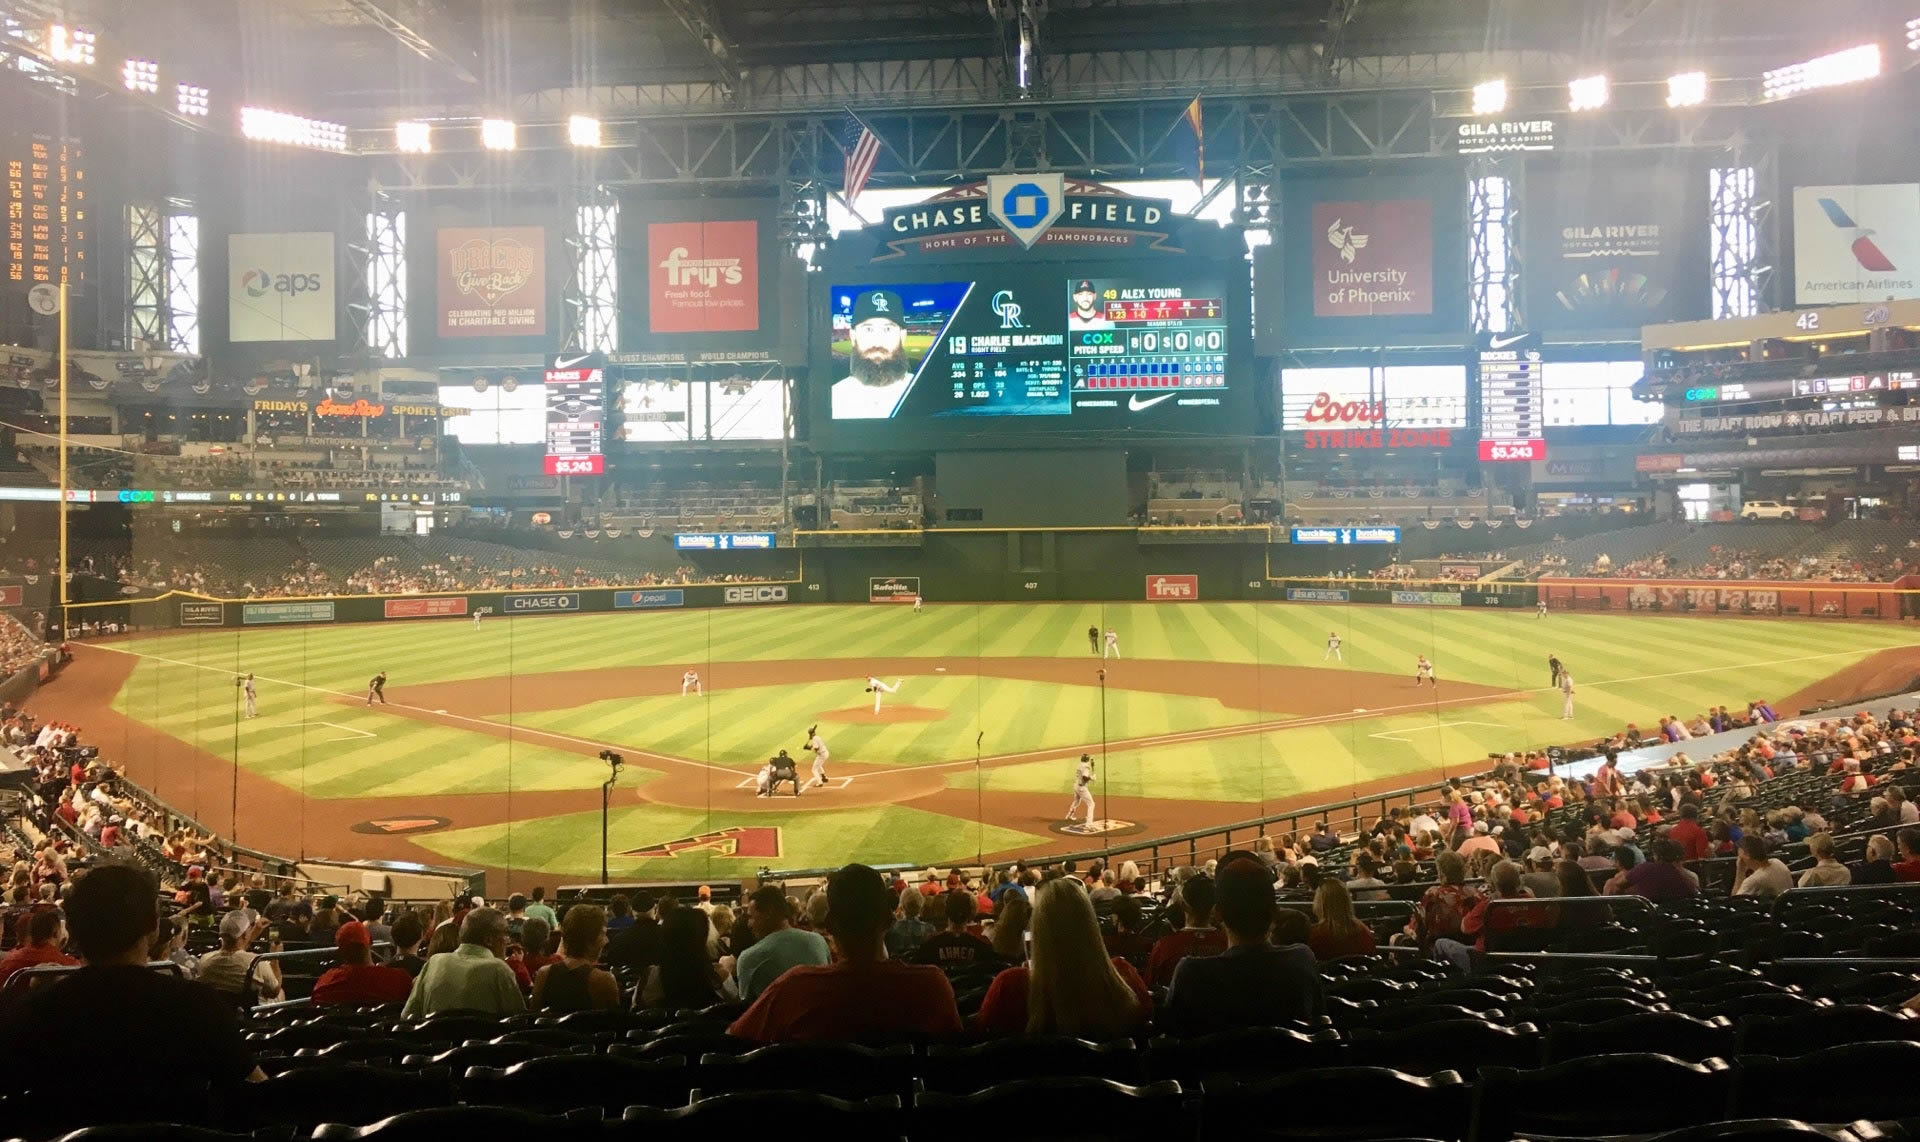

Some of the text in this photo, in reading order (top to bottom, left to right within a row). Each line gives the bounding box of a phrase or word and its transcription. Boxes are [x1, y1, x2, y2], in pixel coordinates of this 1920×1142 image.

[1459, 120, 1553, 136] GILA RIVER
[1510, 135, 1554, 143] CASINOS
[9, 161, 22, 169] 44
[9, 181, 22, 189] 57
[12, 190, 22, 198] 15
[9, 210, 22, 218] 57
[893, 203, 1161, 232] CHASE FIELD
[10, 222, 22, 230] 24
[1562, 224, 1659, 239] GILA RIVER
[10, 231, 22, 239] 39
[925, 233, 1128, 249] HOME OF THE DIAMONDBACKS
[10, 243, 22, 251] 62
[13, 251, 22, 259] 19
[660, 247, 743, 288] fry's
[10, 271, 22, 280] 56
[1328, 268, 1408, 286] University
[274, 273, 320, 296] aps
[1805, 279, 1914, 290] American Airlines
[665, 290, 689, 299] Fresh
[1103, 288, 1182, 300] 49 ALEX YOUNG
[1329, 288, 1412, 303] of Phoenix
[448, 308, 535, 318] CELEBRATING MILLION
[1109, 310, 1126, 319] 1.23
[1133, 310, 1146, 319] 1-0
[1157, 309, 1170, 318] 7.1
[1863, 306, 1889, 324] 20
[448, 316, 535, 326] IN CHARITABLE GIVING
[1796, 312, 1819, 329] 42
[971, 335, 1063, 346] CHARLIE BLACKMON
[1082, 333, 1113, 344] COX
[1131, 332, 1220, 350] B 0 S 0 0
[949, 336, 967, 354] 19
[1074, 345, 1124, 354] PITCH SPEED
[642, 353, 685, 361] CHAMPIONS
[727, 352, 768, 360] CHAMPIONS
[1480, 351, 1517, 360] ROCKIES
[254, 401, 308, 411] FRIDAY'S
[355, 398, 385, 416] Row
[391, 405, 436, 415] SPORTS
[1304, 391, 1385, 422] Coors
[1679, 420, 1701, 432] THE
[1704, 417, 1743, 431] DRAFT
[1746, 415, 1782, 429] ROOM
[1805, 412, 1844, 427] CRAFT
[1304, 429, 1451, 449] STRIKE ZONE
[1490, 447, 1533, 460] $5,243
[555, 461, 593, 474] $5,243
[119, 490, 154, 502] COX
[245, 492, 252, 500] 0
[267, 492, 274, 500] 0
[442, 492, 460, 501] 1:10
[873, 583, 907, 591] Safelite
[1152, 578, 1191, 596] fry's
[644, 594, 665, 604] pepsi
[726, 586, 787, 601] GEICO
[1400, 593, 1421, 602] COX
[1718, 589, 1778, 608] Farm
[514, 598, 556, 608] CHASE
[480, 606, 493, 614] 368
